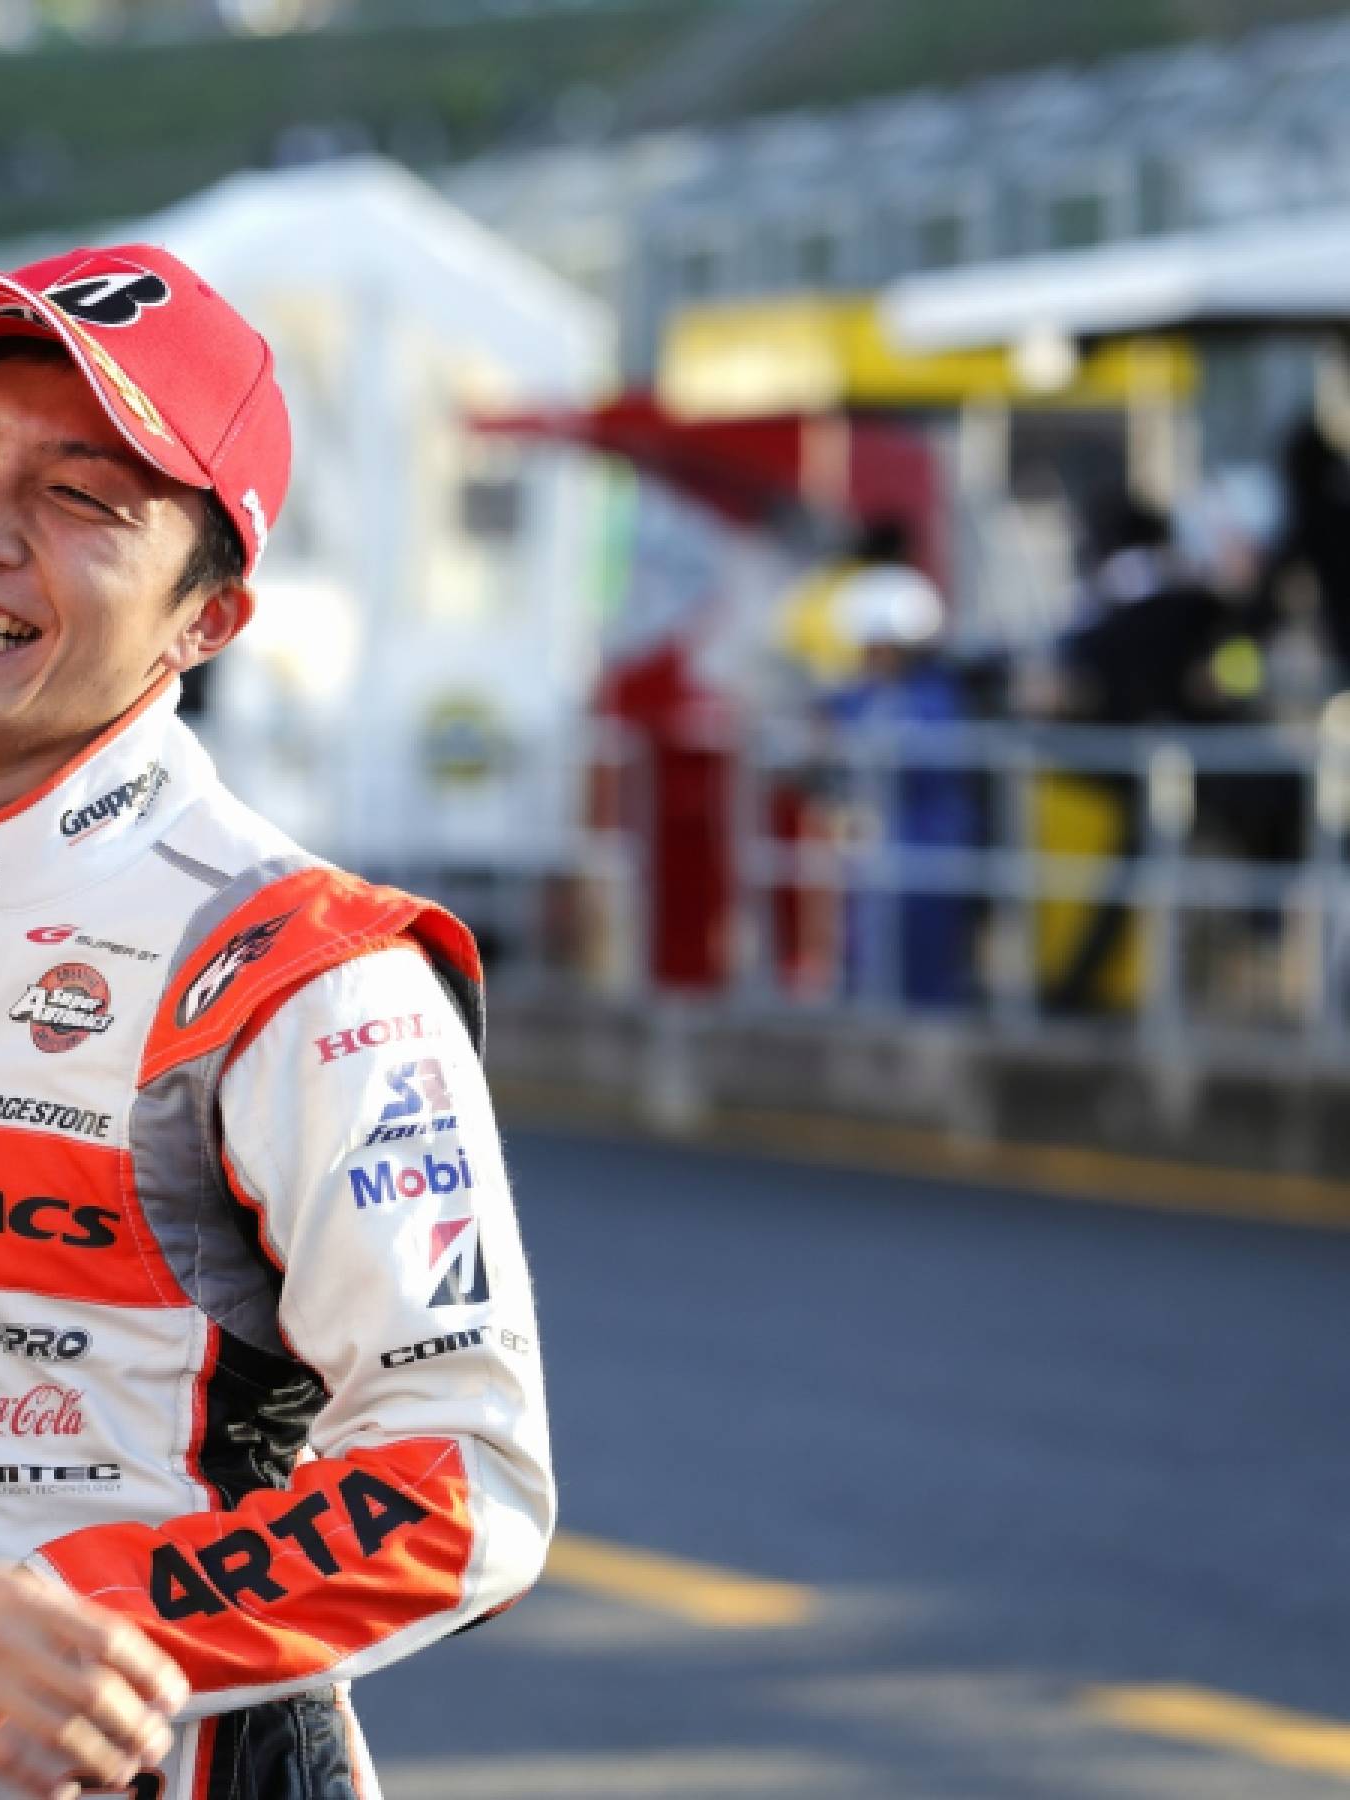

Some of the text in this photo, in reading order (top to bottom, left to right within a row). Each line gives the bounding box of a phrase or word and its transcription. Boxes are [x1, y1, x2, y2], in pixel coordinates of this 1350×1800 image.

[313, 1013, 441, 1065] HON
[349, 1148, 473, 1209] Mobi
[150, 1469, 431, 1621] ARTA
